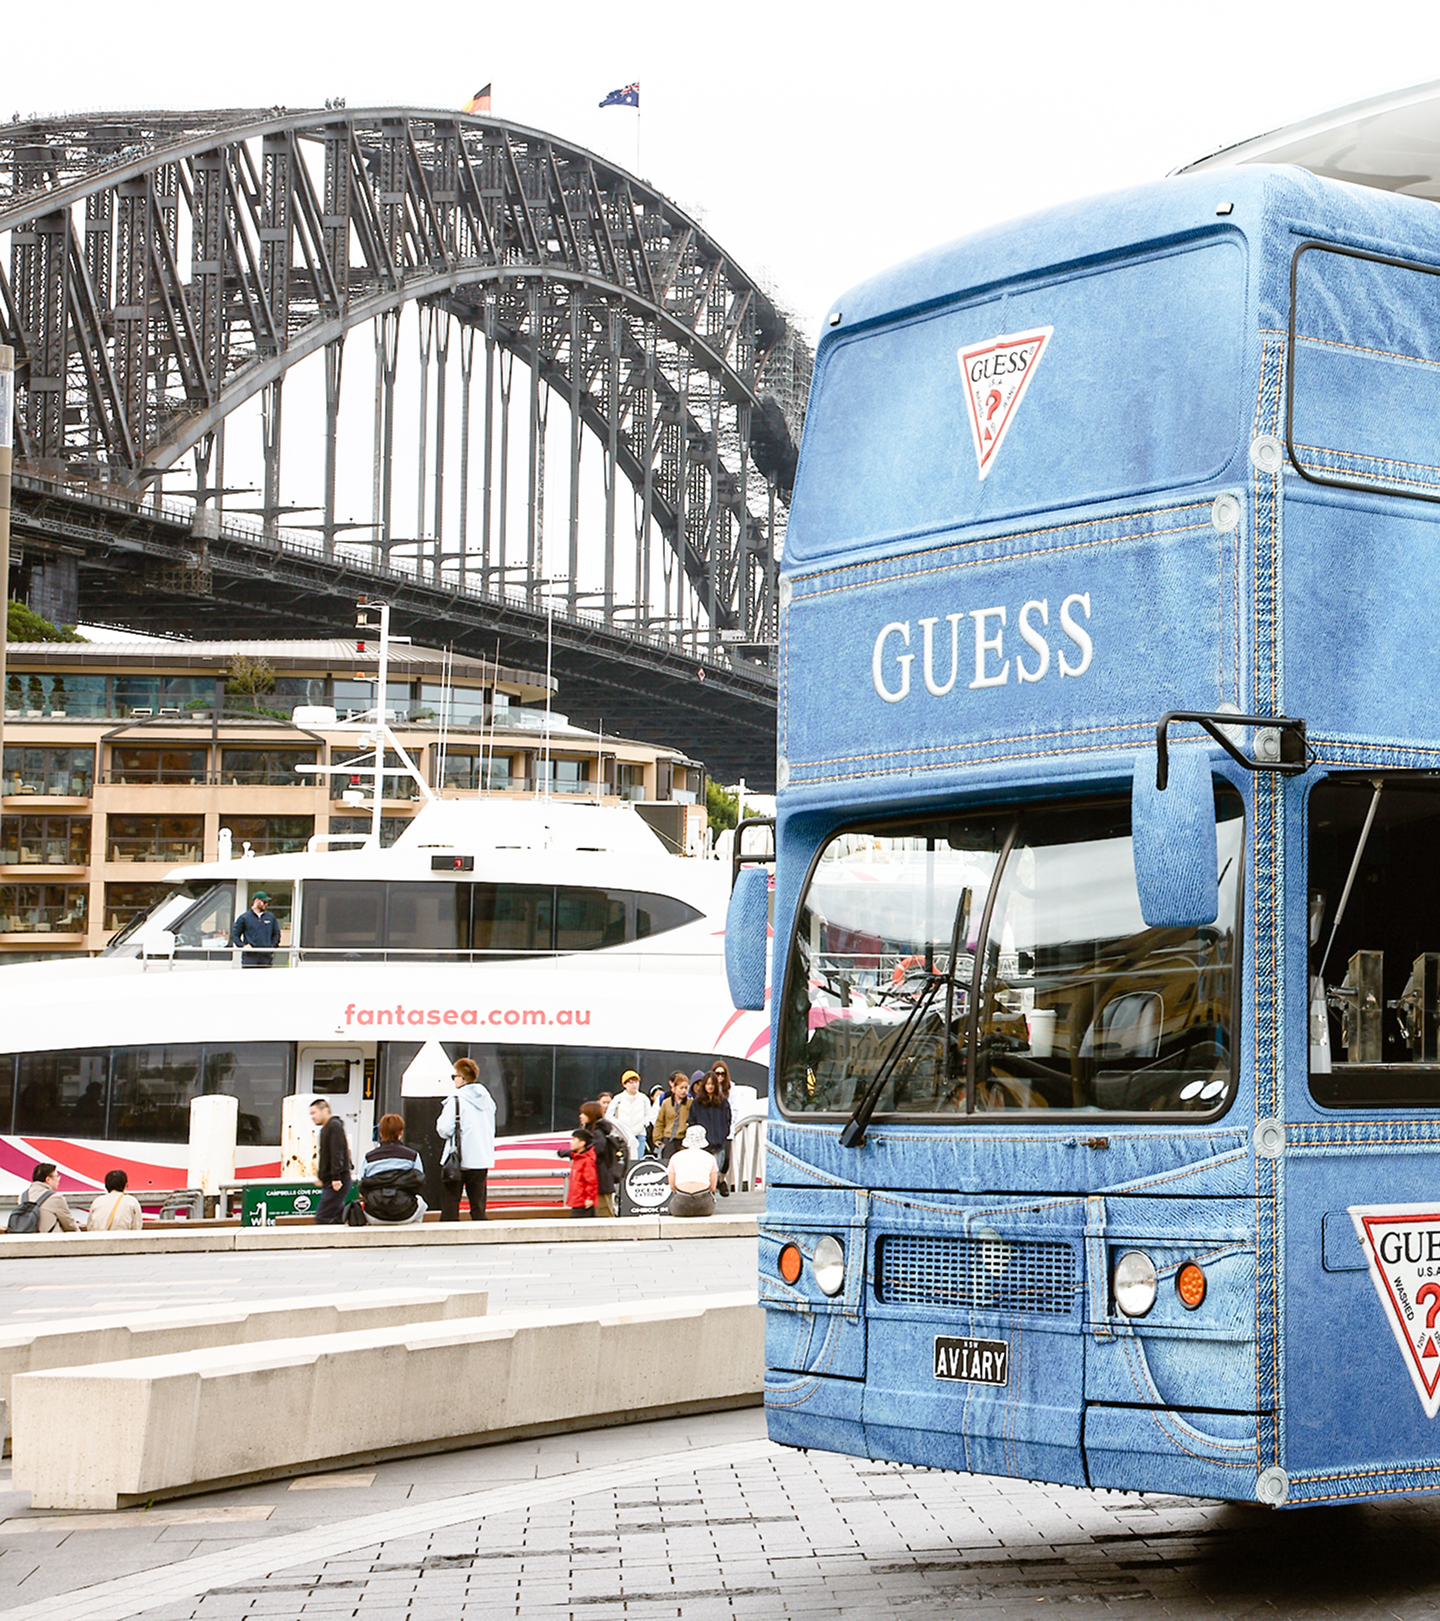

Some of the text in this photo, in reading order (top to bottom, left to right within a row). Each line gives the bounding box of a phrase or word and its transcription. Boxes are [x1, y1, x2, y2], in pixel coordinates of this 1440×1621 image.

[872, 591, 1093, 704] GUESS
[344, 1003, 591, 1025] fantasea.com.au
[1393, 1277, 1414, 1321] WASHED
[937, 1347, 1005, 1381] AVIARY
